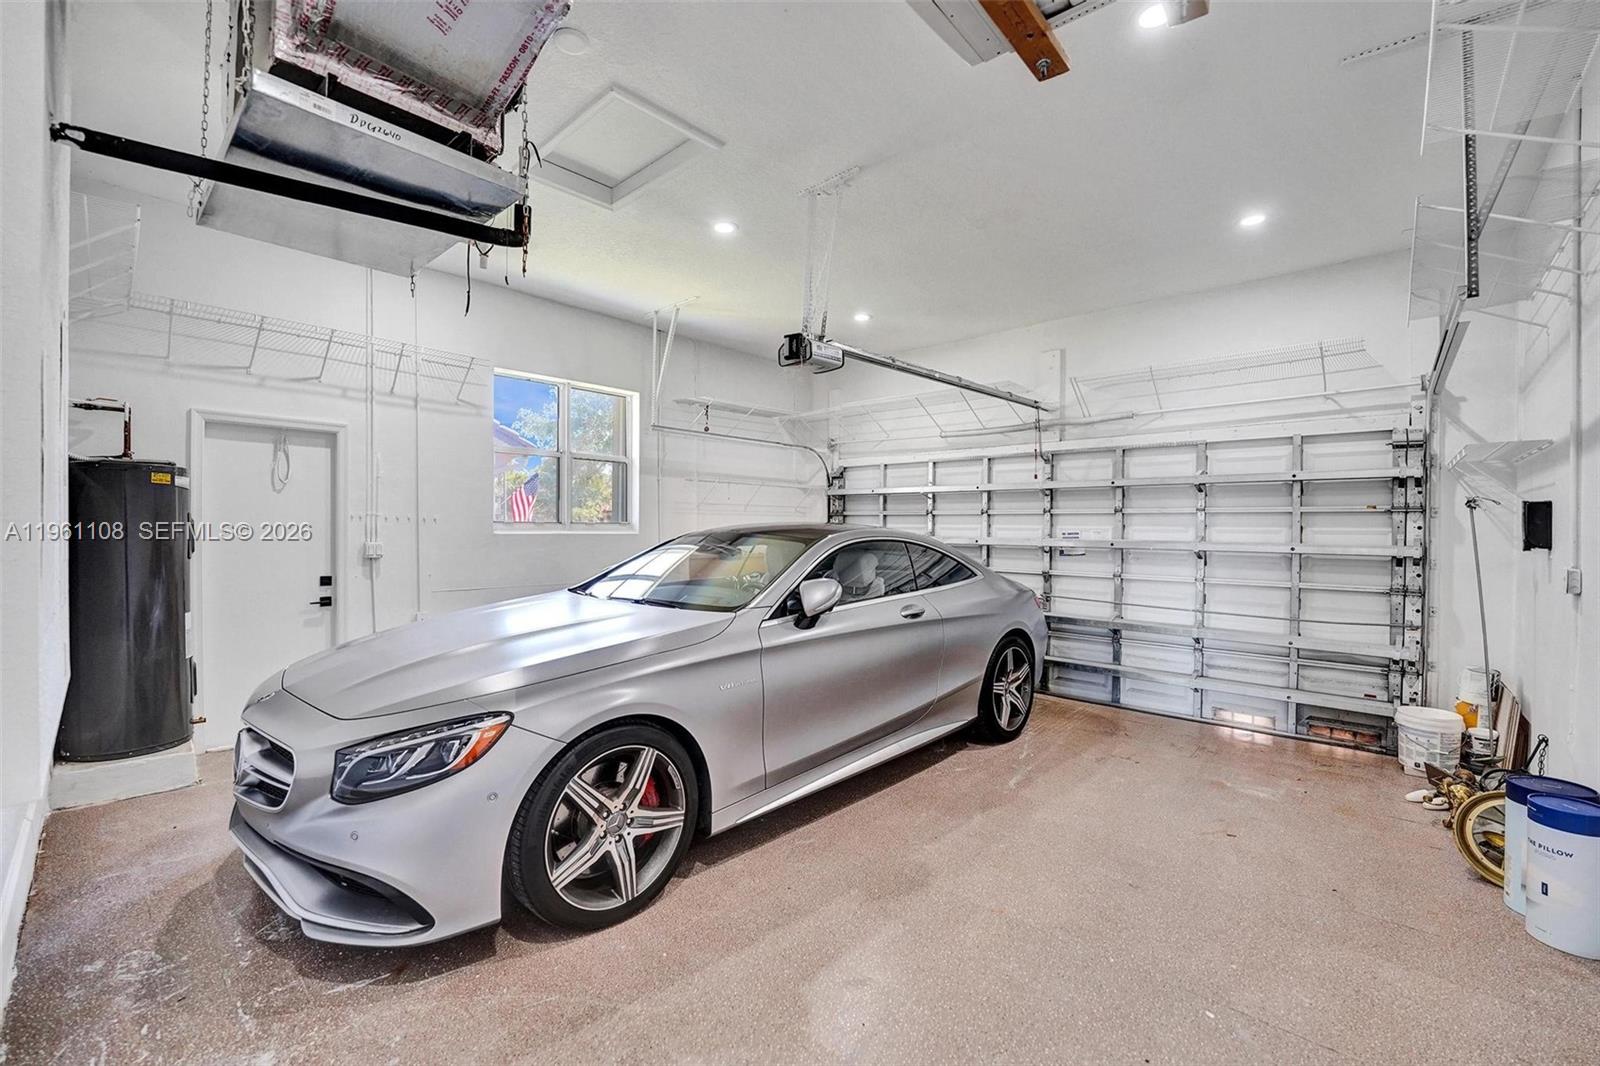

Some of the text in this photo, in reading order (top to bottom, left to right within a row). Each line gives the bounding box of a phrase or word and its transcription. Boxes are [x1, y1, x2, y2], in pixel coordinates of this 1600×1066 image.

[499, 56, 520, 85] FASSON
[519, 34, 534, 54] 0810
[1538, 842, 1574, 858] PILLOW
